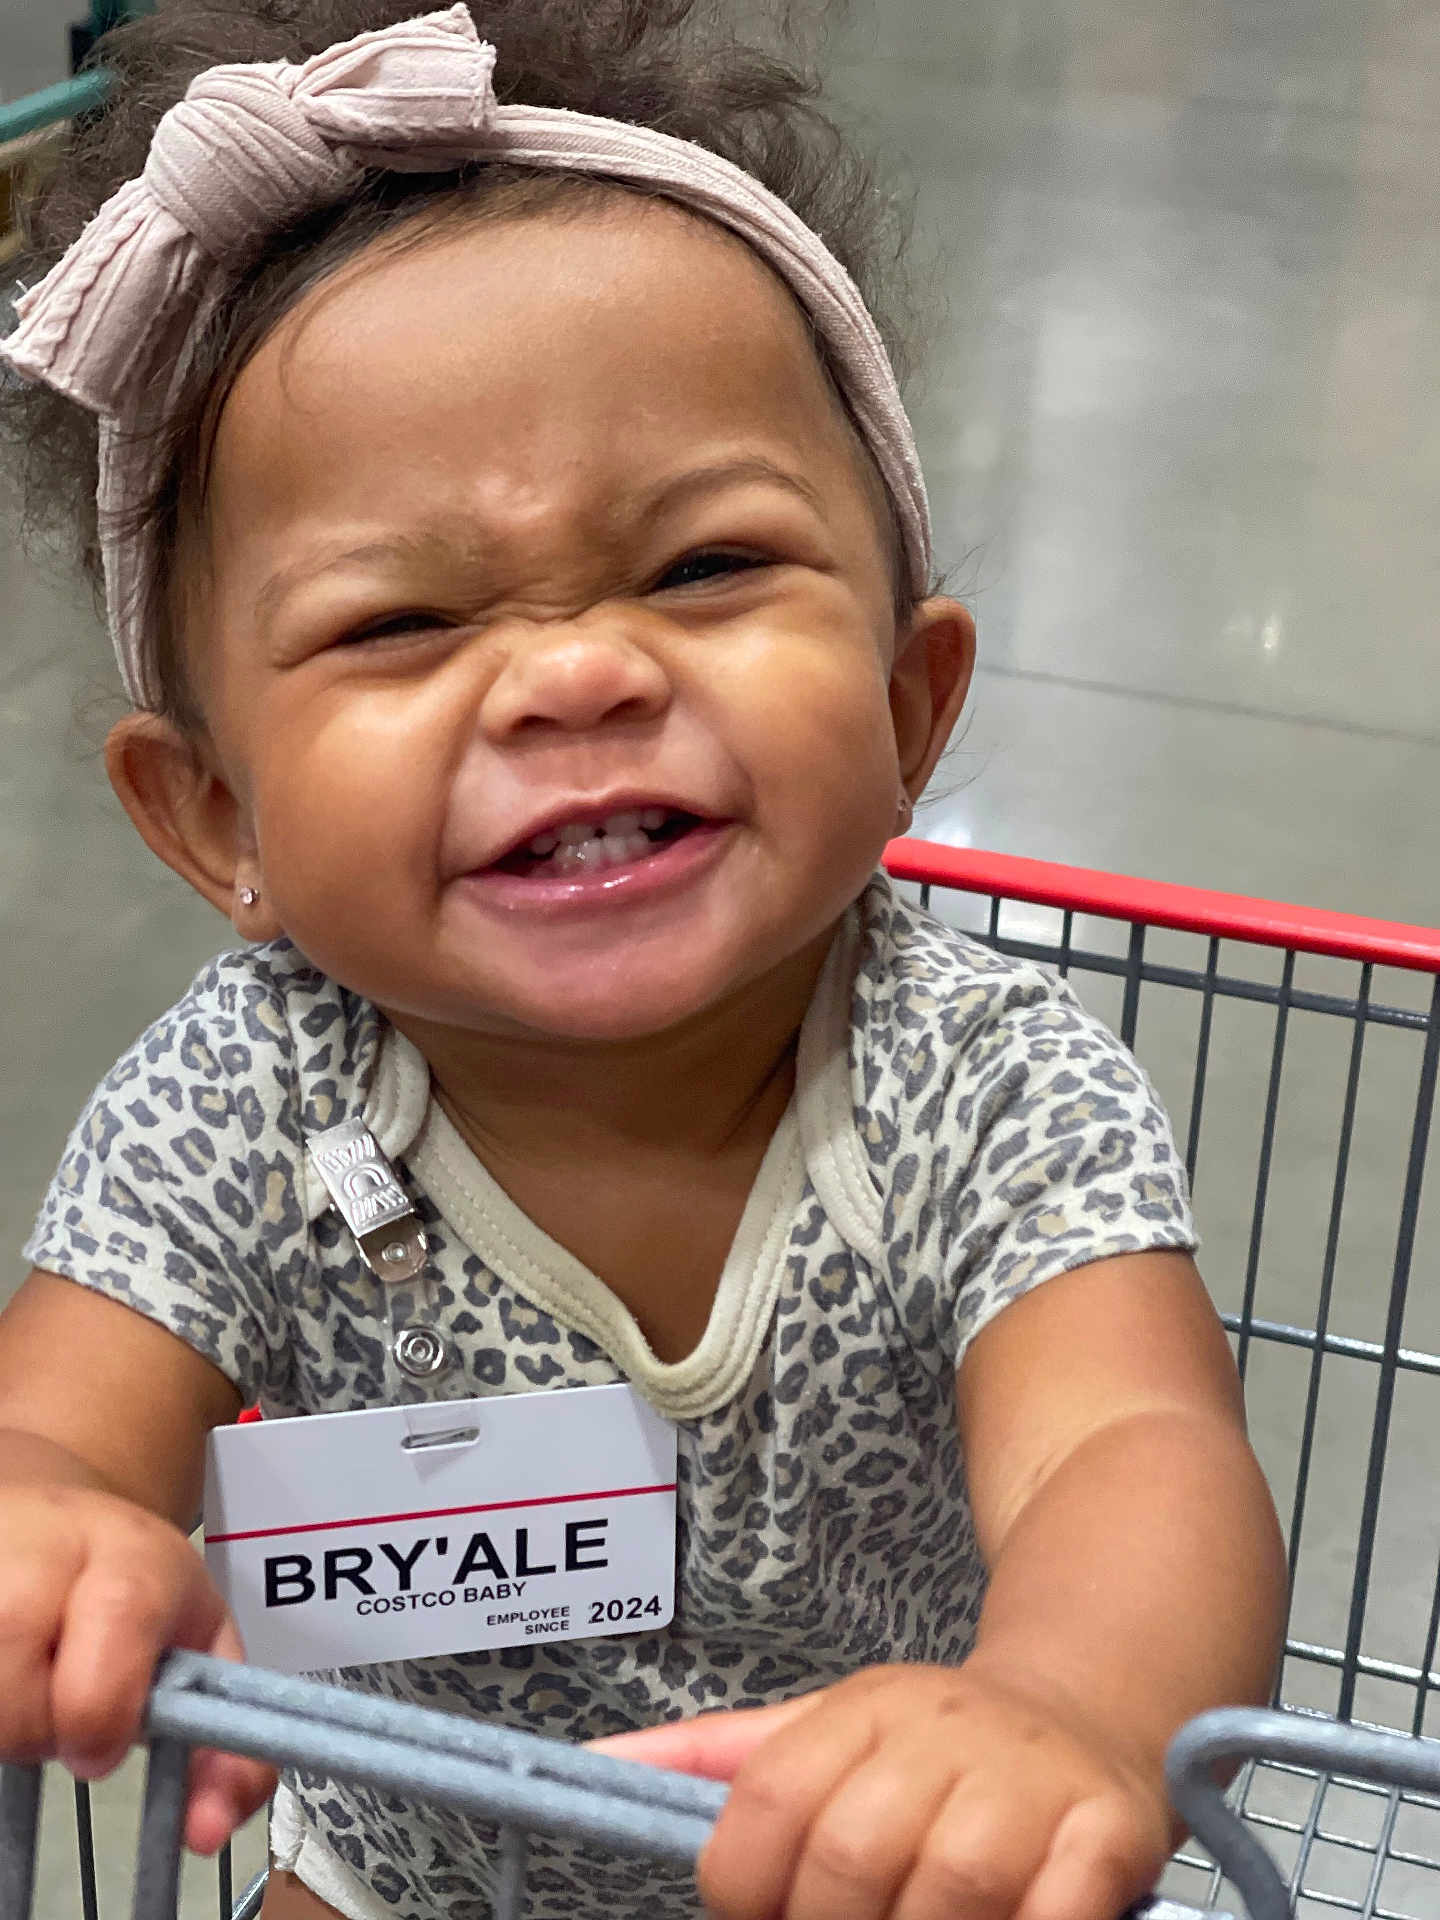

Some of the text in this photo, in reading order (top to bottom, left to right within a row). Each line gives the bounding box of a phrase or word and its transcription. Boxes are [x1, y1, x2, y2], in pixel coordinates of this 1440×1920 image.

[265, 1519, 608, 1608] BRY'ALE
[357, 1581, 527, 1616] COSTCO BABY
[590, 1595, 663, 1624] 2024
[486, 1606, 570, 1626] EMPLOYEE
[524, 1620, 569, 1635] SINCE
